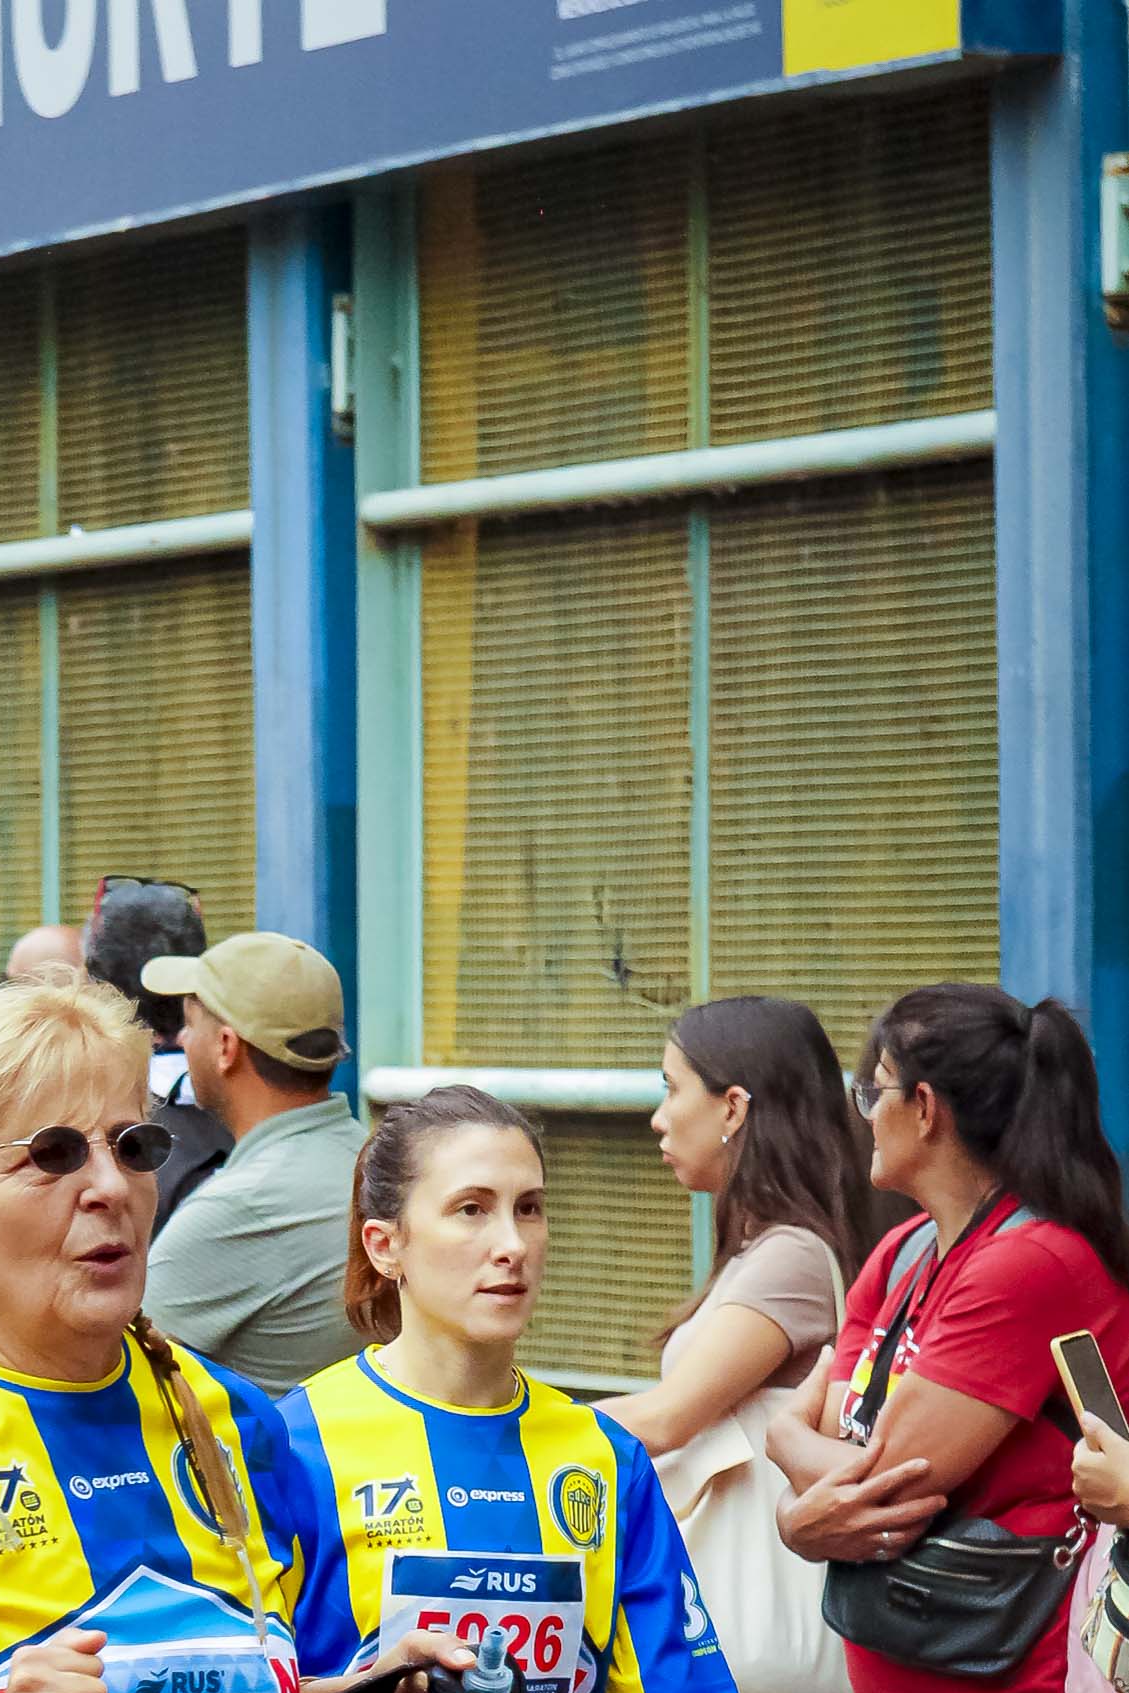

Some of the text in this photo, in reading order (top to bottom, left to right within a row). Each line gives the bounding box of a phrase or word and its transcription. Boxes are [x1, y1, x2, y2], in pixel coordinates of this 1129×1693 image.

[91, 1471, 150, 1490] express
[469, 1488, 525, 1502] express
[364, 1516, 424, 1531] MARATÓN
[366, 1525, 425, 1539] CANALLA
[486, 1571, 537, 1593] RUS
